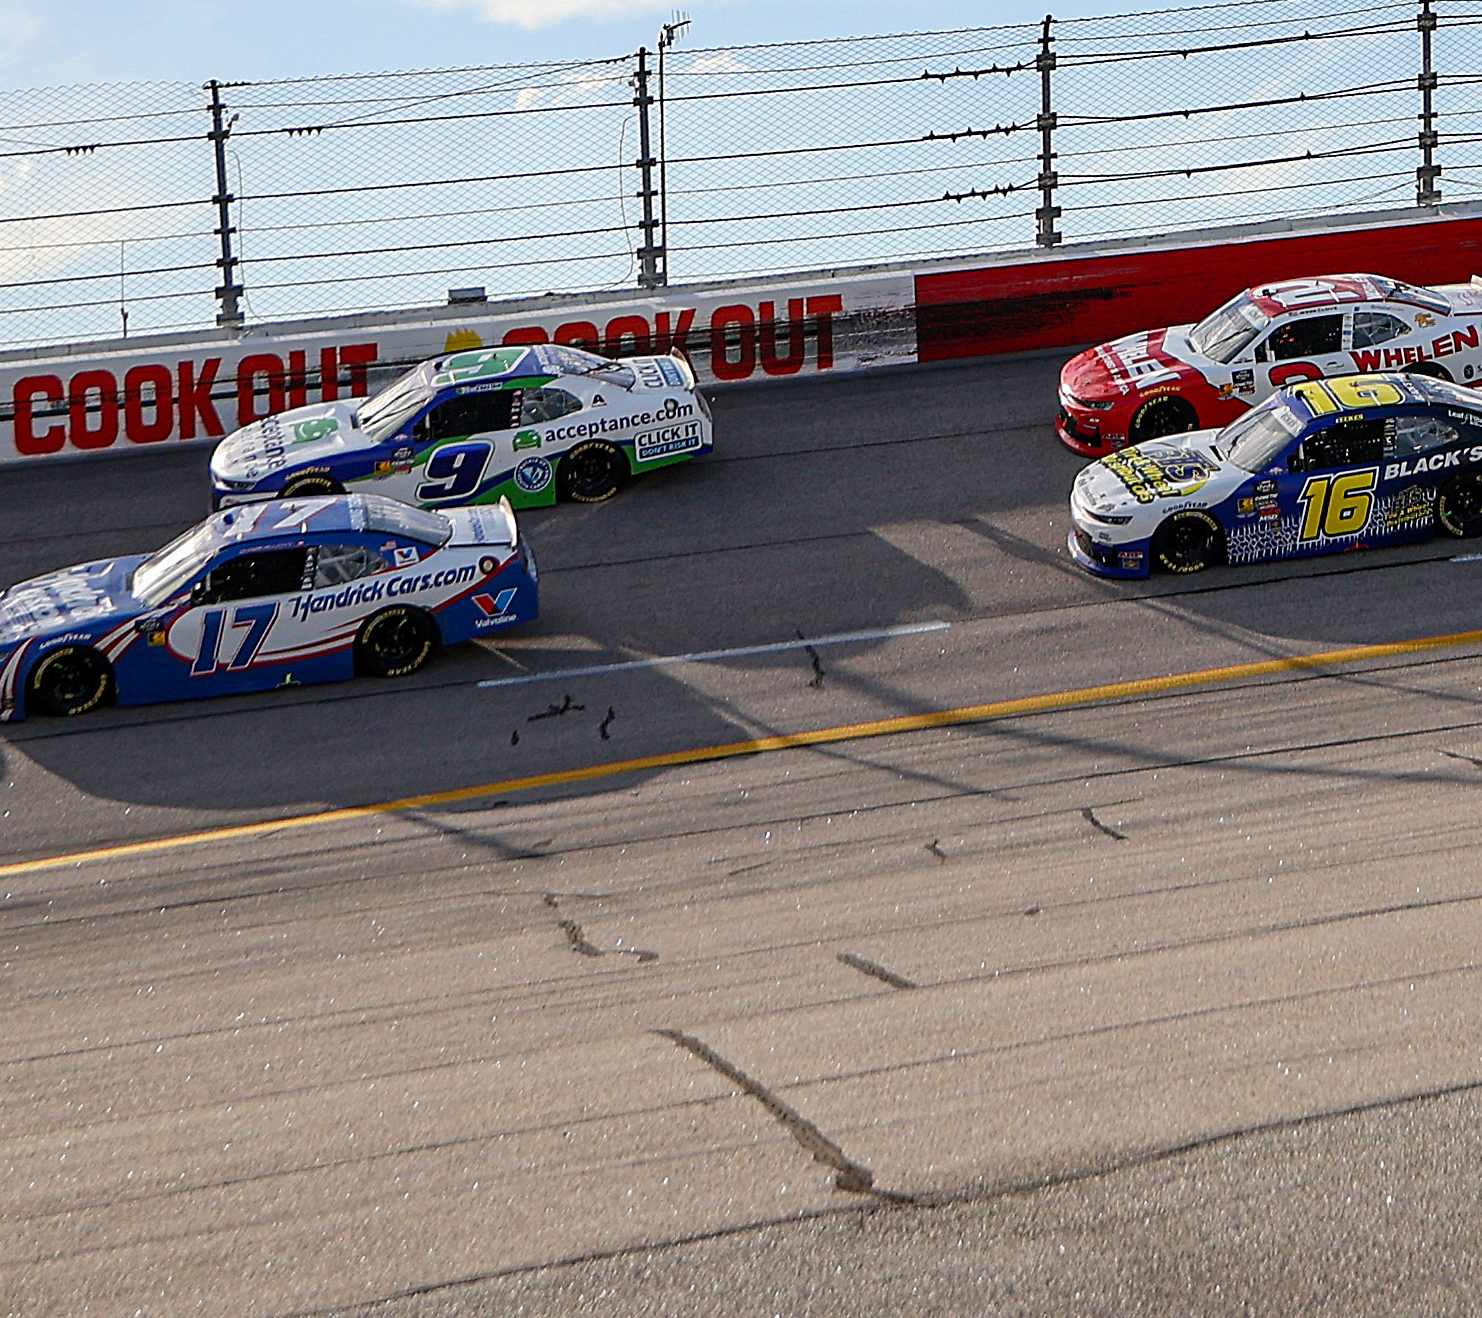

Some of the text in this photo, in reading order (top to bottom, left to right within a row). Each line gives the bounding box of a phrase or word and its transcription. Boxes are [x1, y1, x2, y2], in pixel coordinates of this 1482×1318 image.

[710, 293, 843, 381] OUT
[1106, 331, 1183, 390] WHELEN
[1349, 324, 1482, 374] WHELEN
[13, 357, 226, 456] COOK
[237, 342, 378, 427] OUT
[1291, 371, 1404, 418] 16
[545, 403, 693, 444] acceptance.com
[637, 422, 699, 448] CLICK IT
[668, 441, 687, 452] RISK
[415, 438, 496, 501] 9
[222, 498, 341, 538] 17
[1297, 465, 1381, 543] 16
[190, 602, 281, 677] 17
[474, 613, 518, 629] Valvoline
